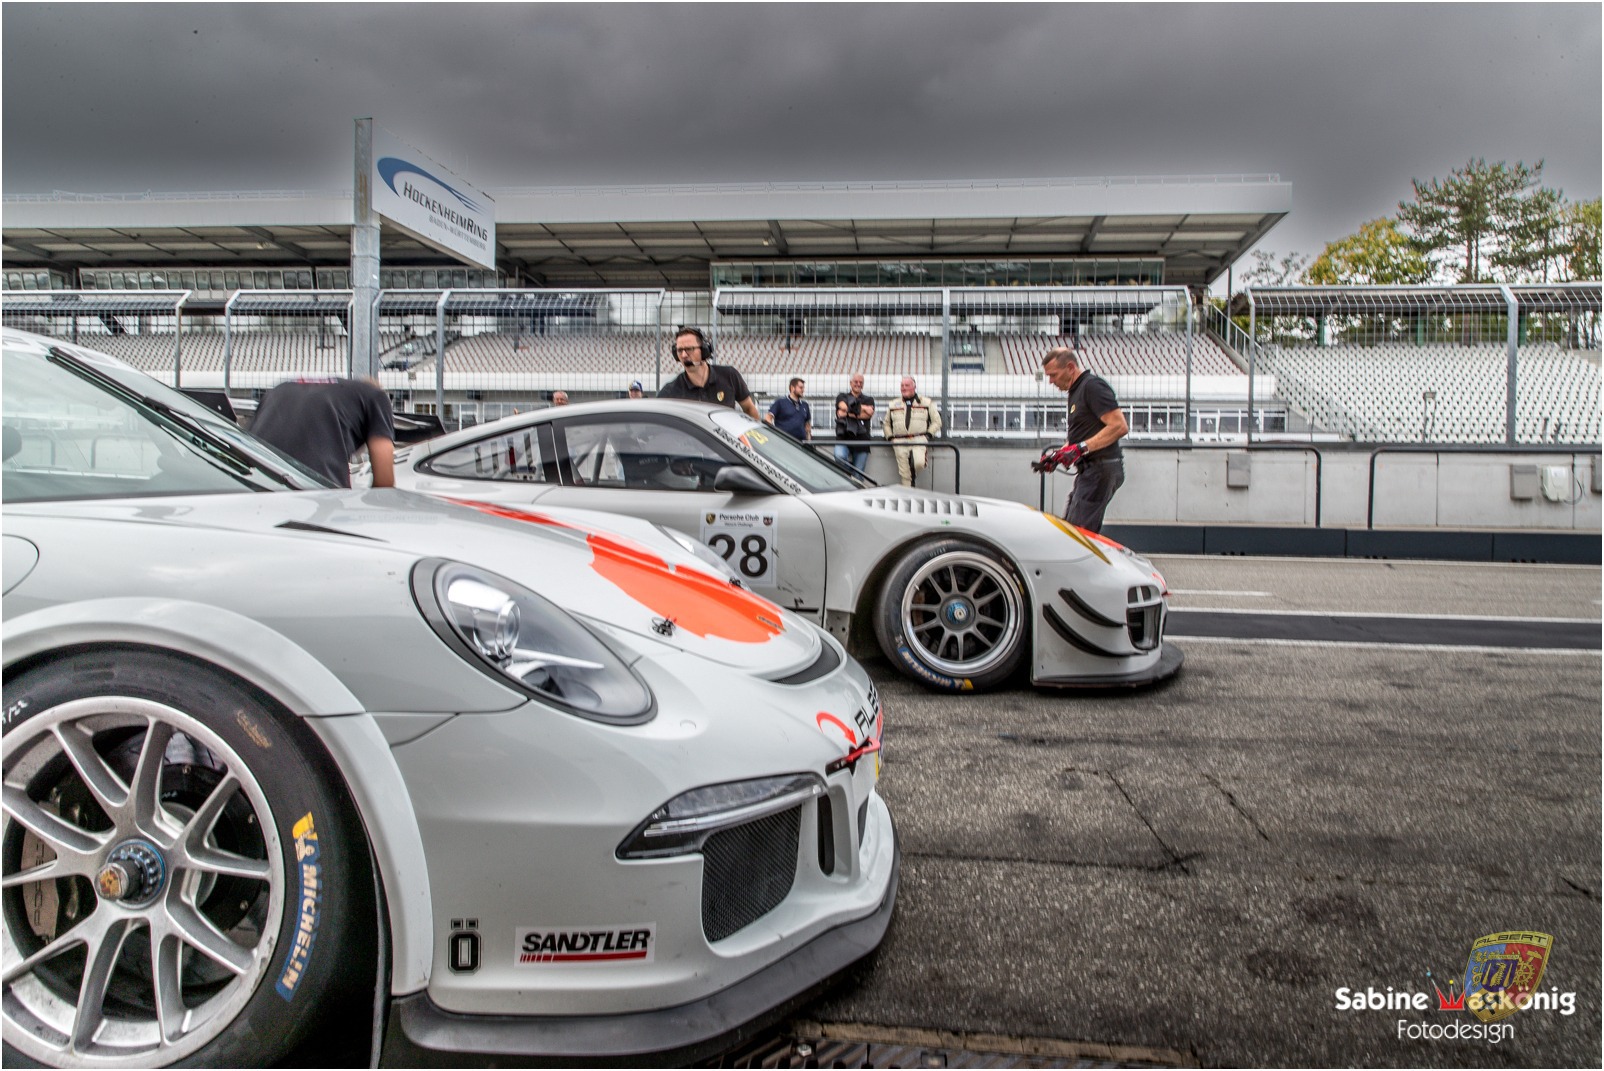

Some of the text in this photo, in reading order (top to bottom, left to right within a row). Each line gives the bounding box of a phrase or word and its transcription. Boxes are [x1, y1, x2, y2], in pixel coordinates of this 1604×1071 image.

[403, 181, 488, 241] HOCKENHEIMRING
[719, 512, 760, 522] Porsche Club
[708, 533, 768, 578] 28
[281, 863, 318, 991] MICHELIN
[522, 930, 651, 953] SANDTLER
